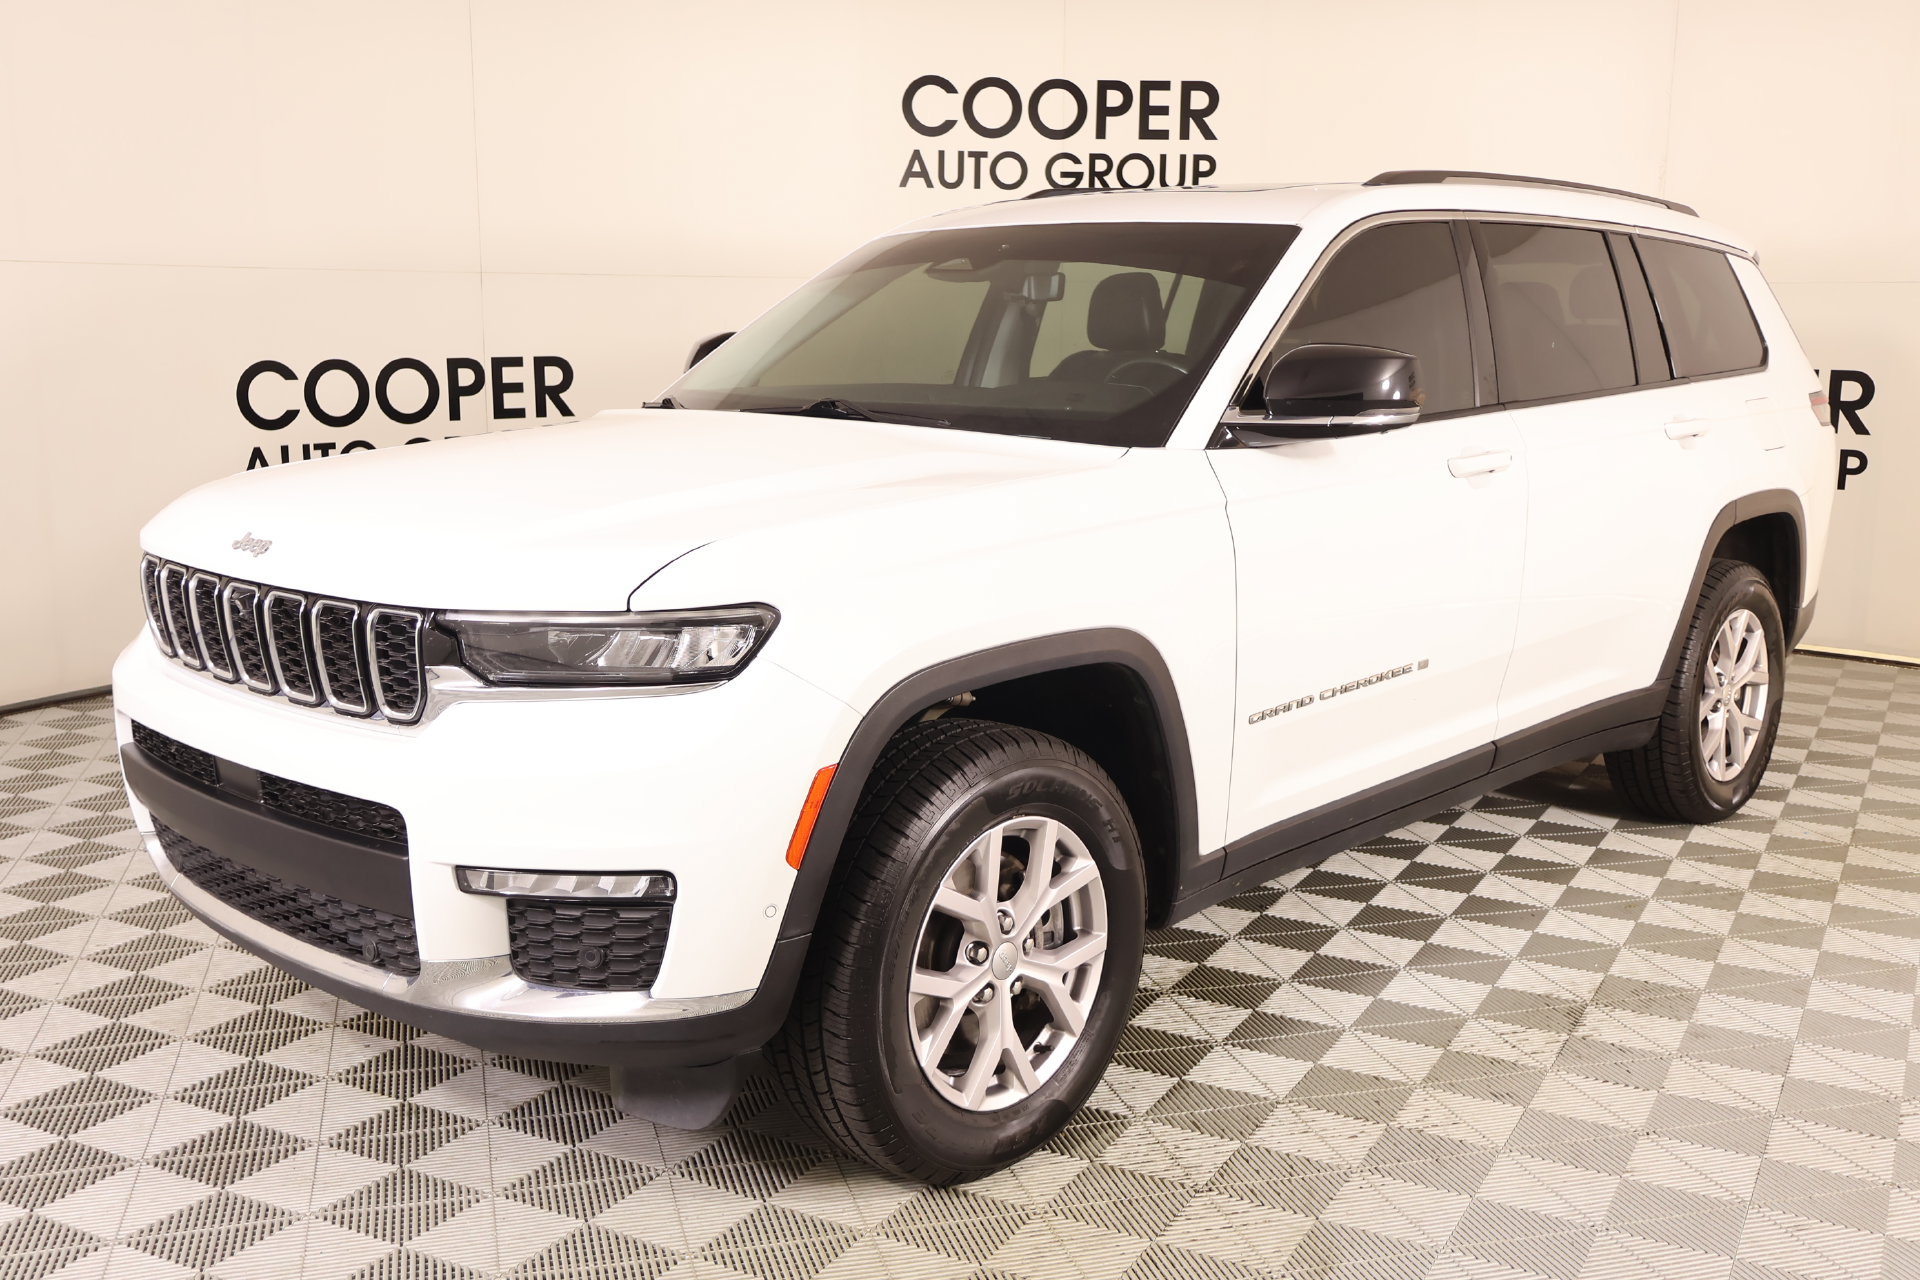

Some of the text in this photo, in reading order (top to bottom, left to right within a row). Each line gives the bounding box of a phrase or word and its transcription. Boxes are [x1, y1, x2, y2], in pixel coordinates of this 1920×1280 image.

[902, 74, 1220, 140] COOPER
[899, 149, 1217, 190] AUTO GROUP
[236, 356, 576, 430] COOPER
[231, 531, 273, 558] Jeep
[1248, 663, 1414, 725] GRAND CHEROKEE
